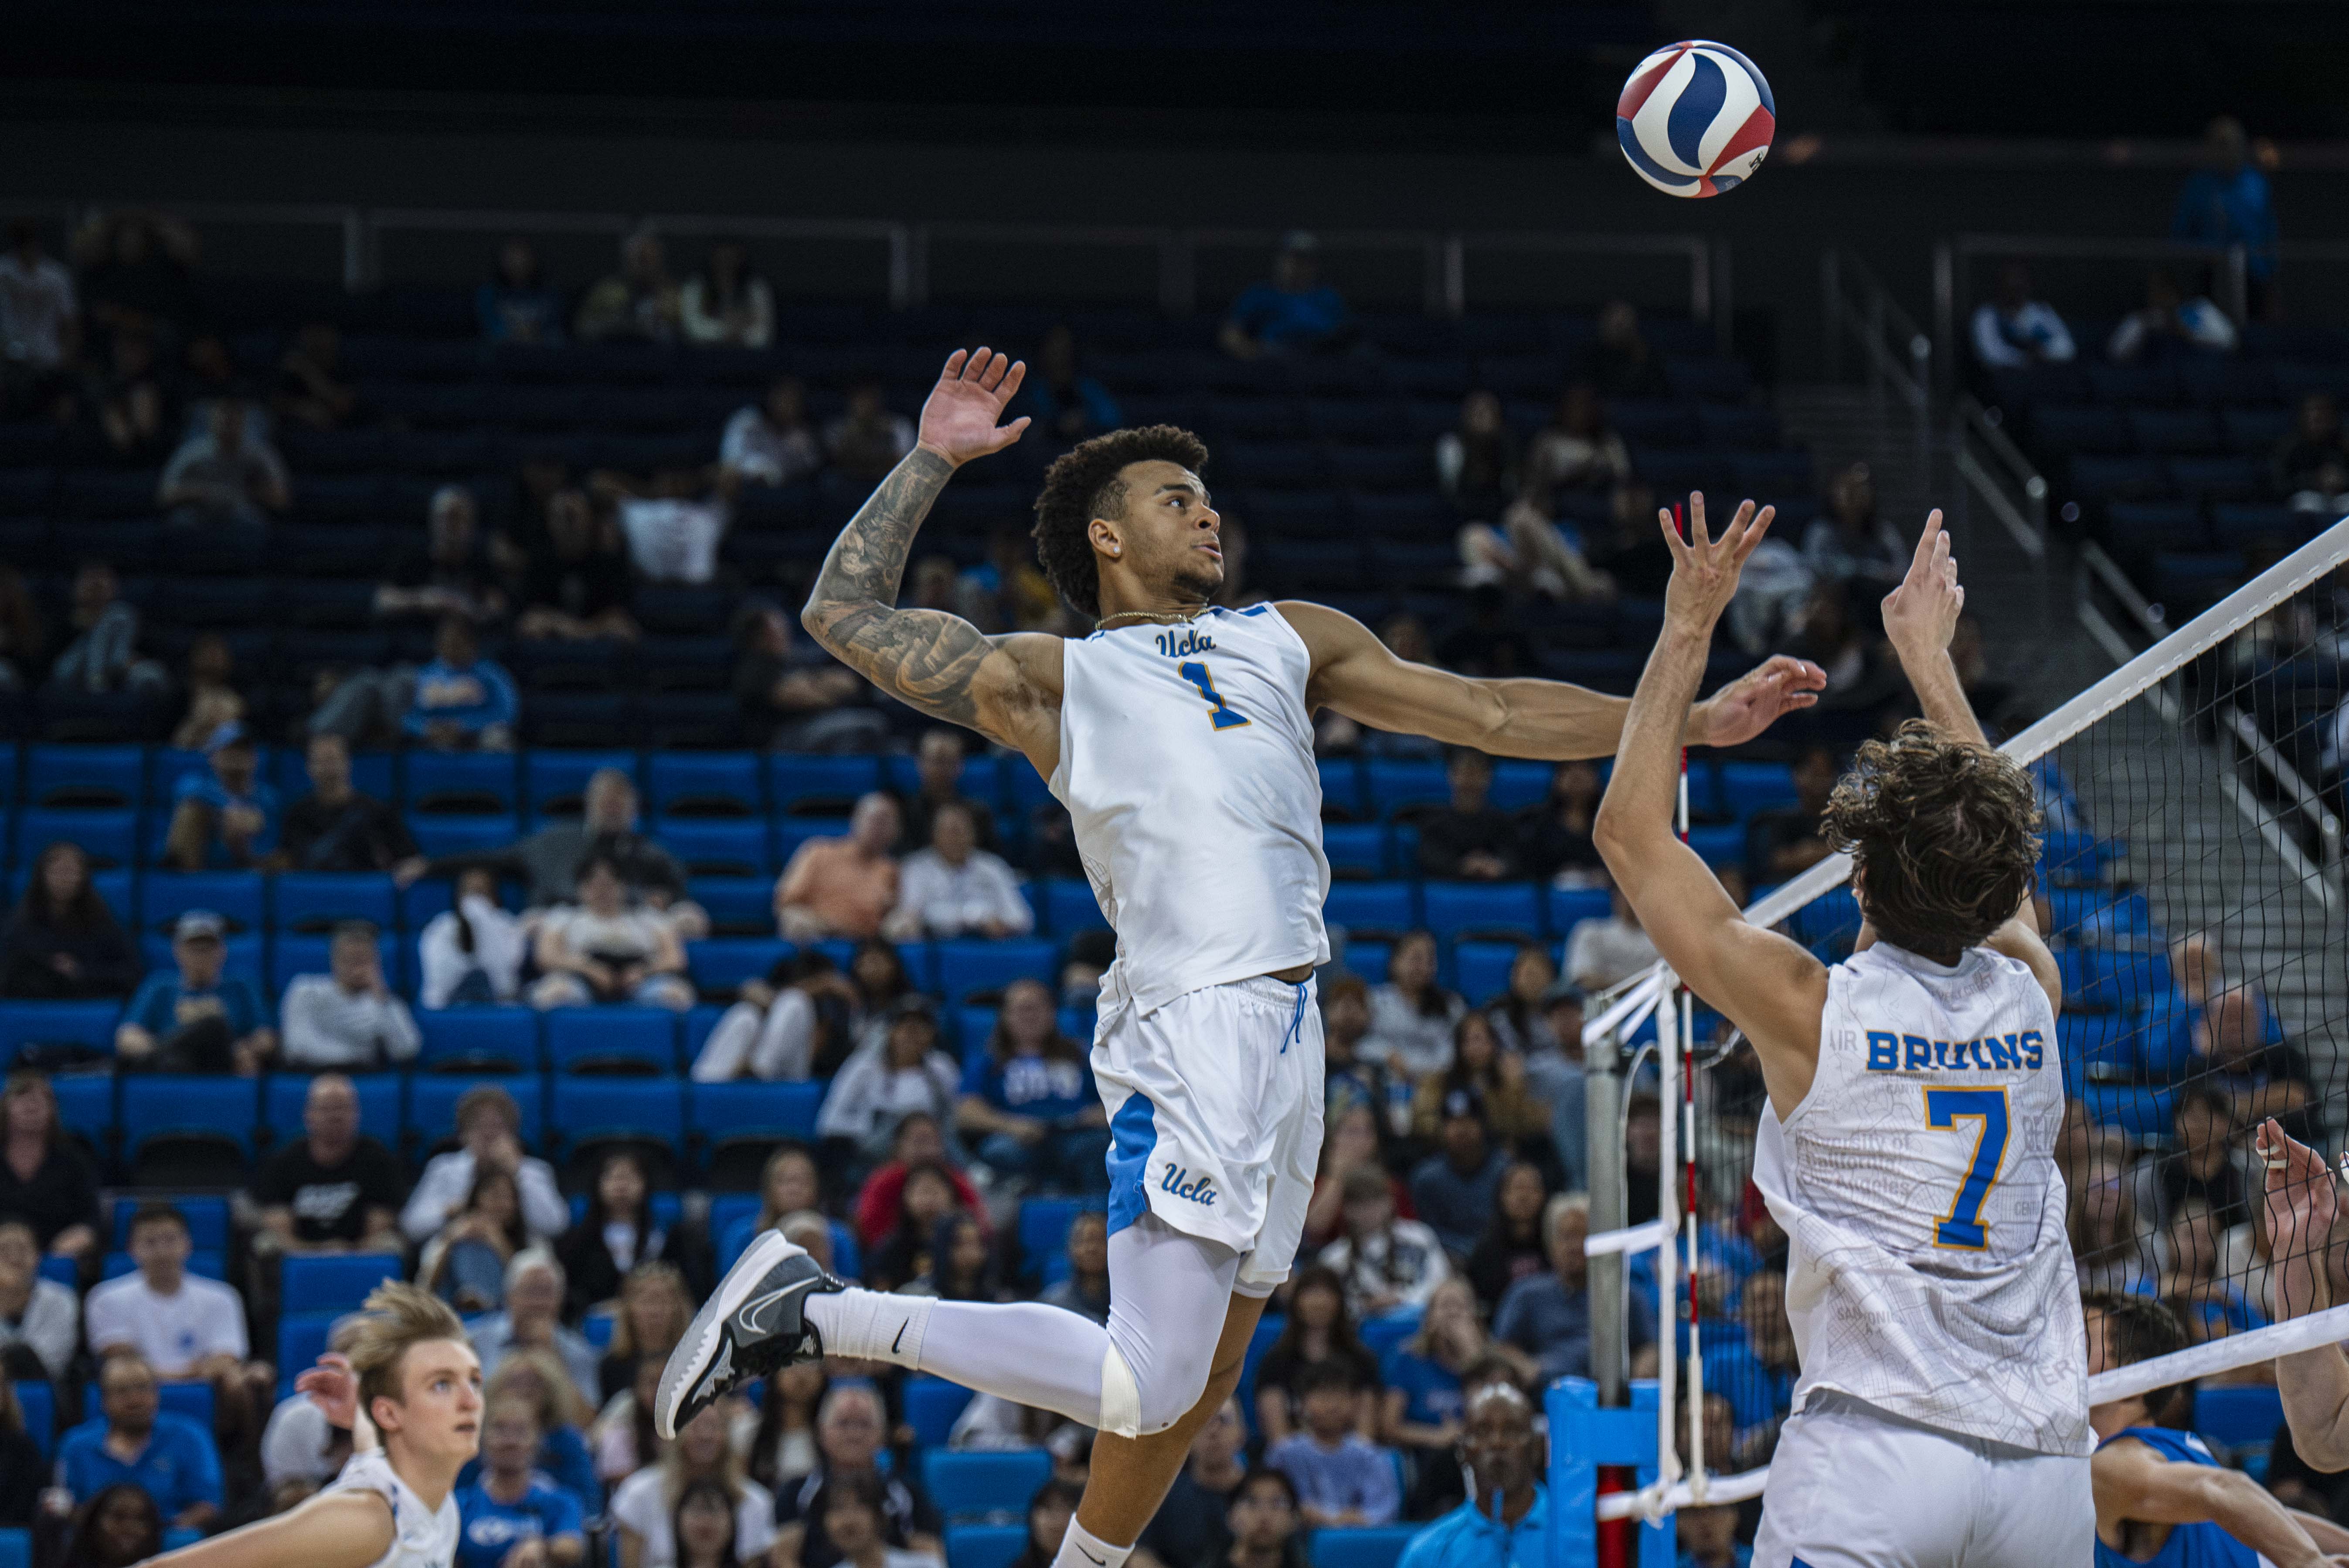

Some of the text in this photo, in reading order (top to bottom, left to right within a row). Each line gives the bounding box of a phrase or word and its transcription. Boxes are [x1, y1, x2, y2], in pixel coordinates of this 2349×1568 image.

[1178, 661, 1252, 732] 1
[1866, 1029, 2044, 1072] BRUINS
[1161, 1163, 1217, 1206] Ucla
[1921, 1085, 2011, 1252] 7
